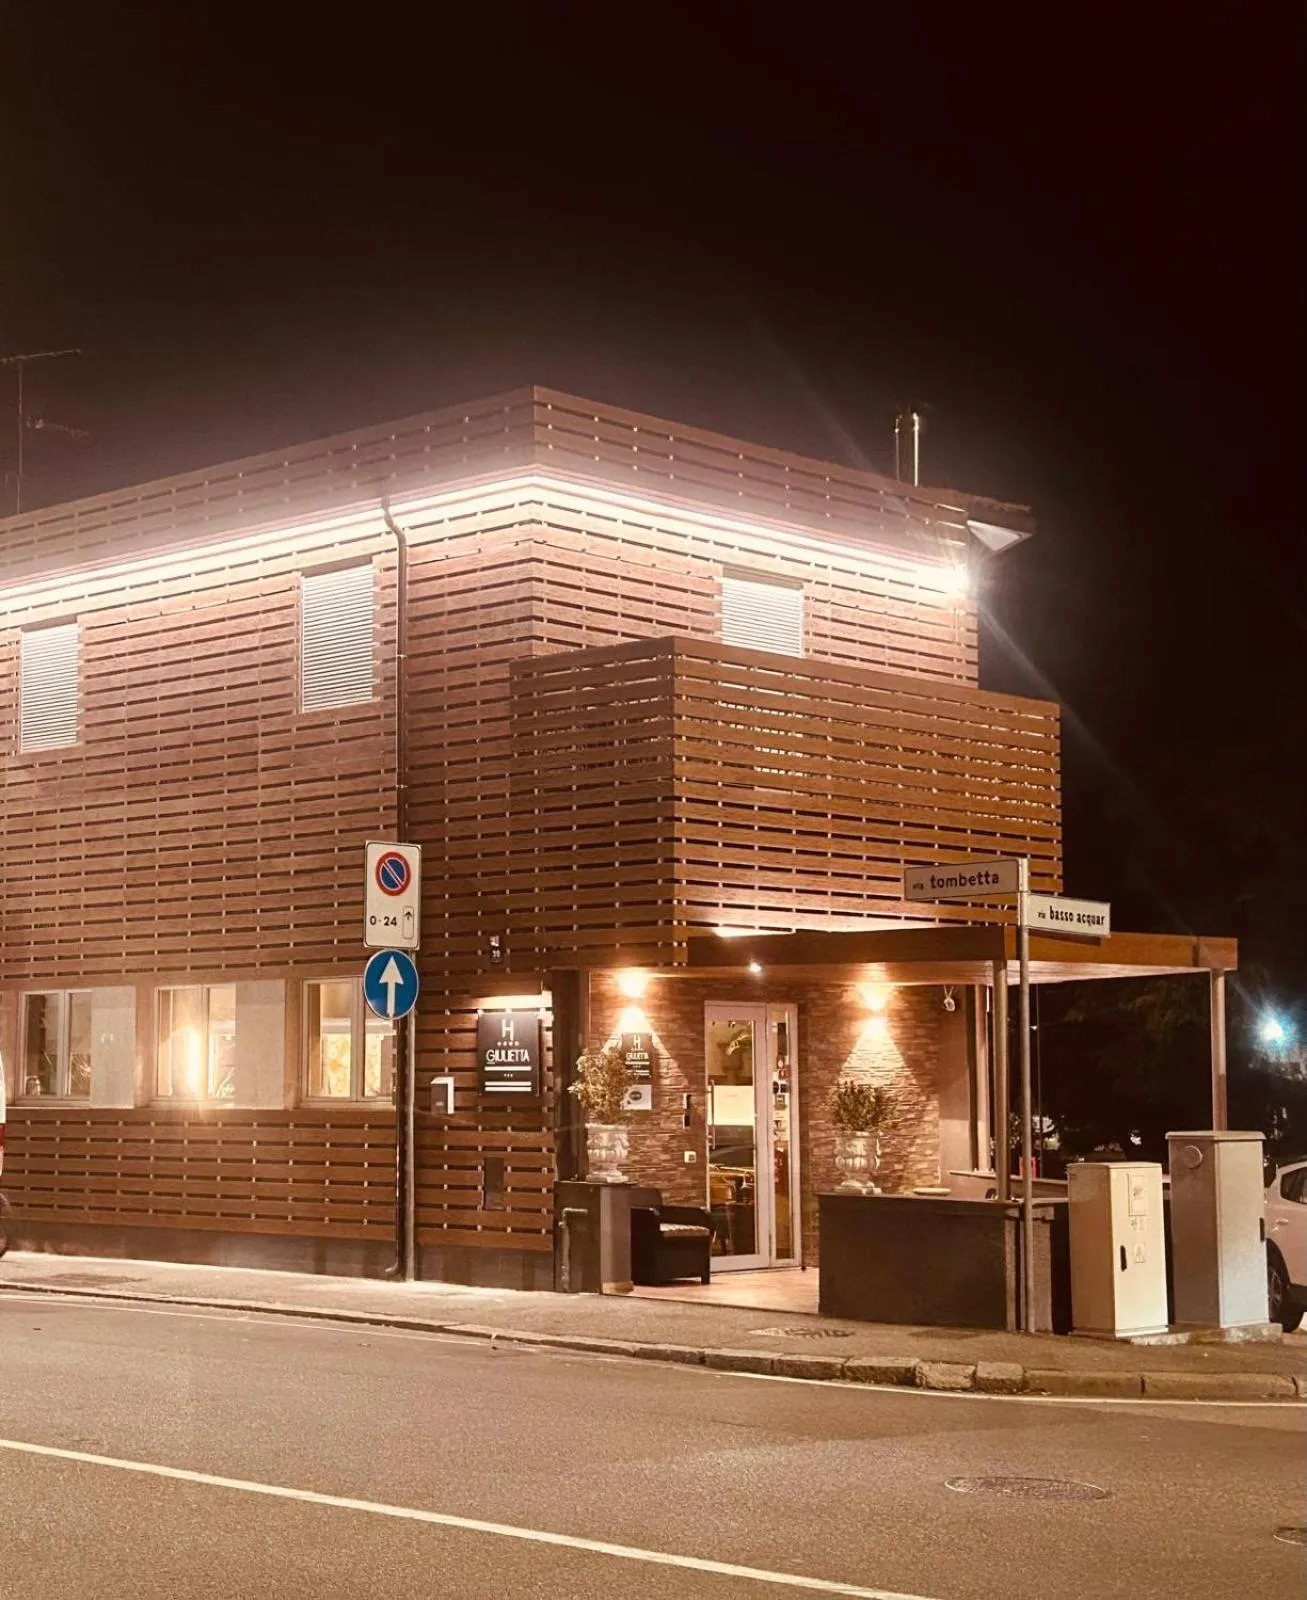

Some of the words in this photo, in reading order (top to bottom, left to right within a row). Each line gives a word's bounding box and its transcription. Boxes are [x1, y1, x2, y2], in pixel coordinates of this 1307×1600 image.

[930, 870, 999, 889] tombetta
[1049, 905, 1073, 922] basso
[1077, 912, 1105, 927] acquar
[502, 1018, 514, 1042] H
[485, 1048, 530, 1063] GIULIETTA
